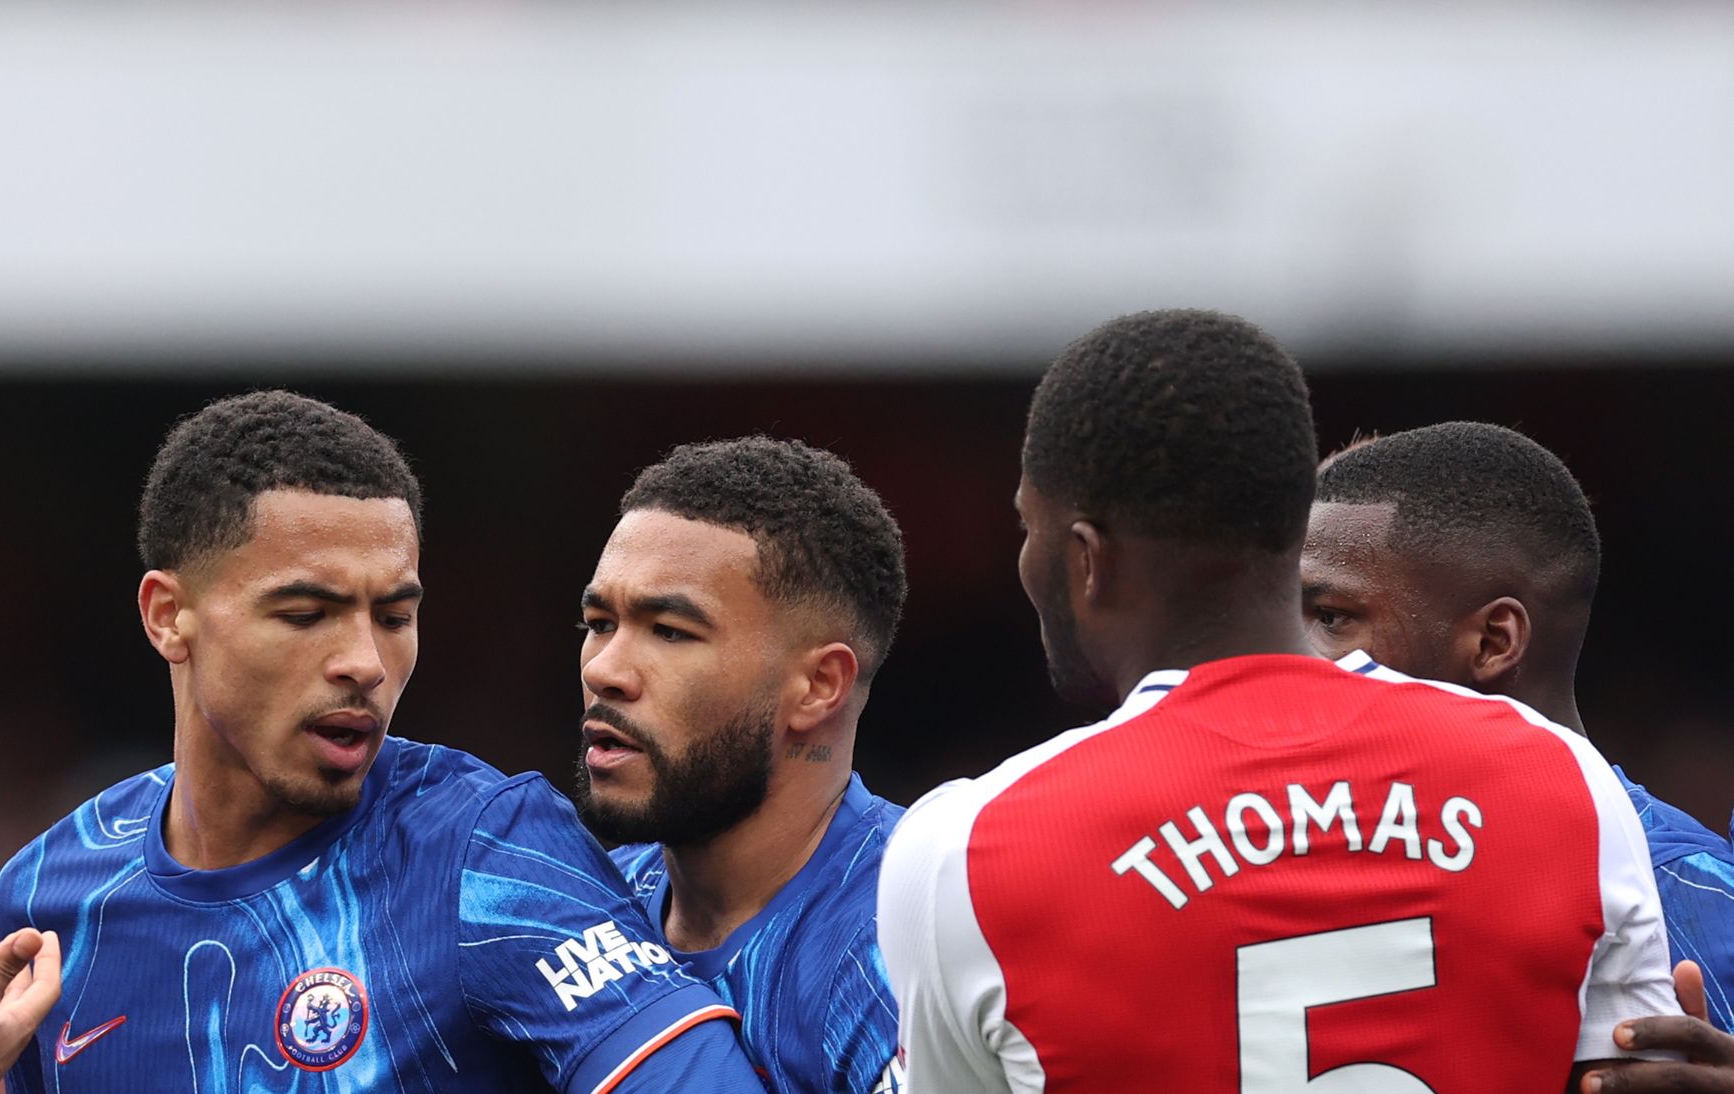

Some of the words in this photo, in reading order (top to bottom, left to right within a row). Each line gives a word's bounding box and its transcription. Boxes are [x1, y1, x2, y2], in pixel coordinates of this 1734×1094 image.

[1111, 781, 1483, 909] THOMAS
[295, 972, 356, 997] CHELSEA
[535, 920, 628, 987] LIVE
[554, 941, 670, 1013] NATIO
[287, 1045, 326, 1063] FOOTBALL
[328, 1044, 348, 1060] CLUB
